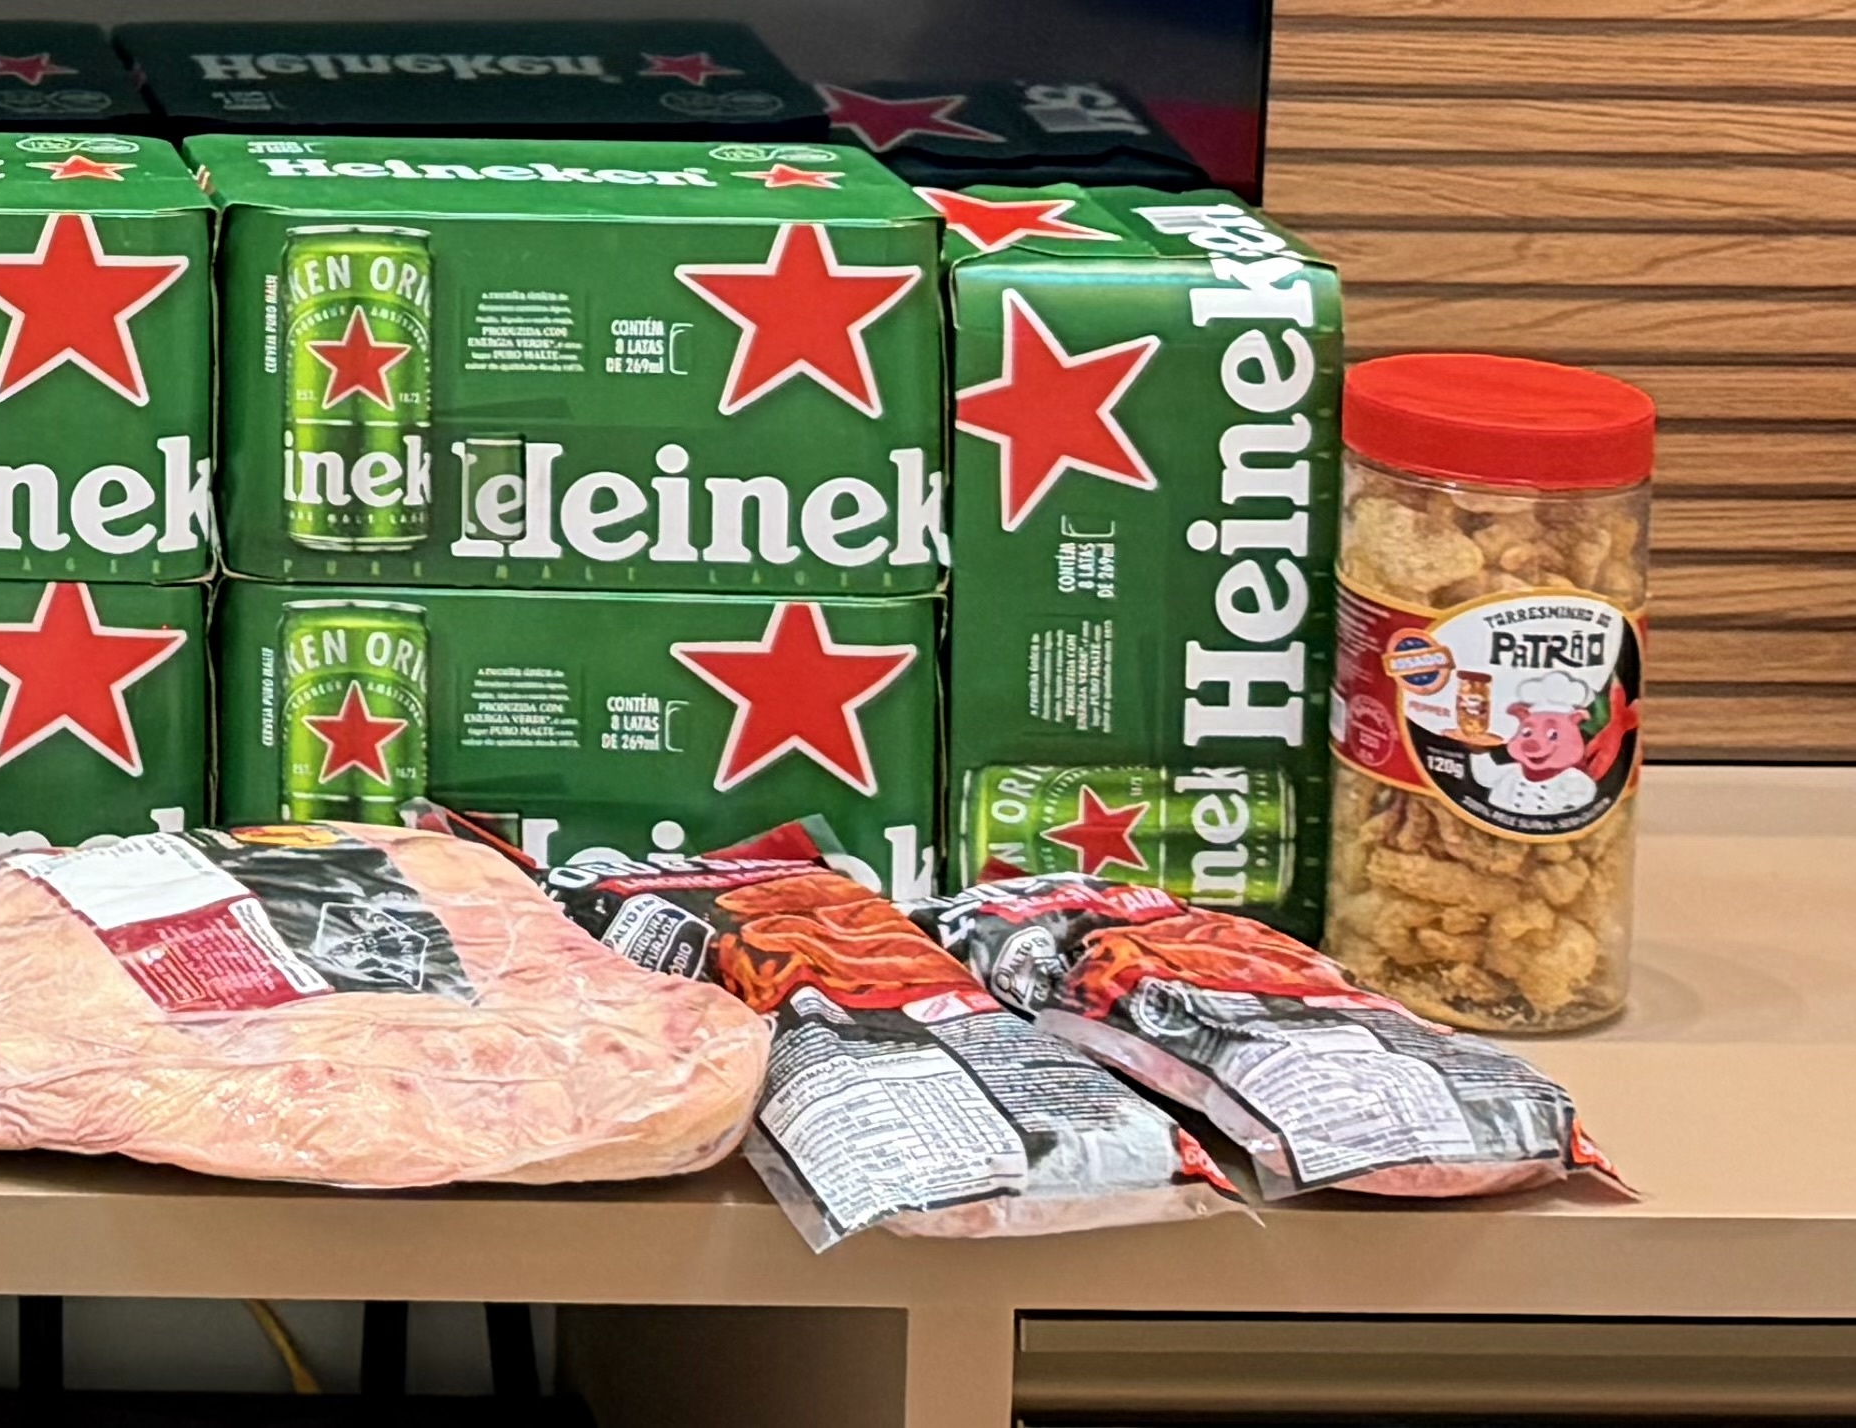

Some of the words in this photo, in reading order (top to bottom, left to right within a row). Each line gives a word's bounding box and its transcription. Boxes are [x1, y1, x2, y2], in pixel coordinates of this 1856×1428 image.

[257, 156, 716, 187] Heineken
[610, 316, 664, 336] CONTÉM
[627, 339, 664, 355] LATAS
[605, 357, 622, 373] DE
[625, 357, 664, 374] 269ml
[284, 430, 432, 507] inek
[1054, 542, 1077, 593] CONTÉM
[1077, 542, 1096, 578] LATAS
[1098, 580, 1116, 598] DE
[1489, 629, 1606, 669] PATRÃO
[606, 693, 660, 713] CONTÉM
[622, 715, 659, 731] LATAS
[601, 733, 617, 749] DE
[620, 733, 660, 751] 269ml
[1426, 755, 1465, 780] 120g
[614, 912, 639, 945] ALTO
